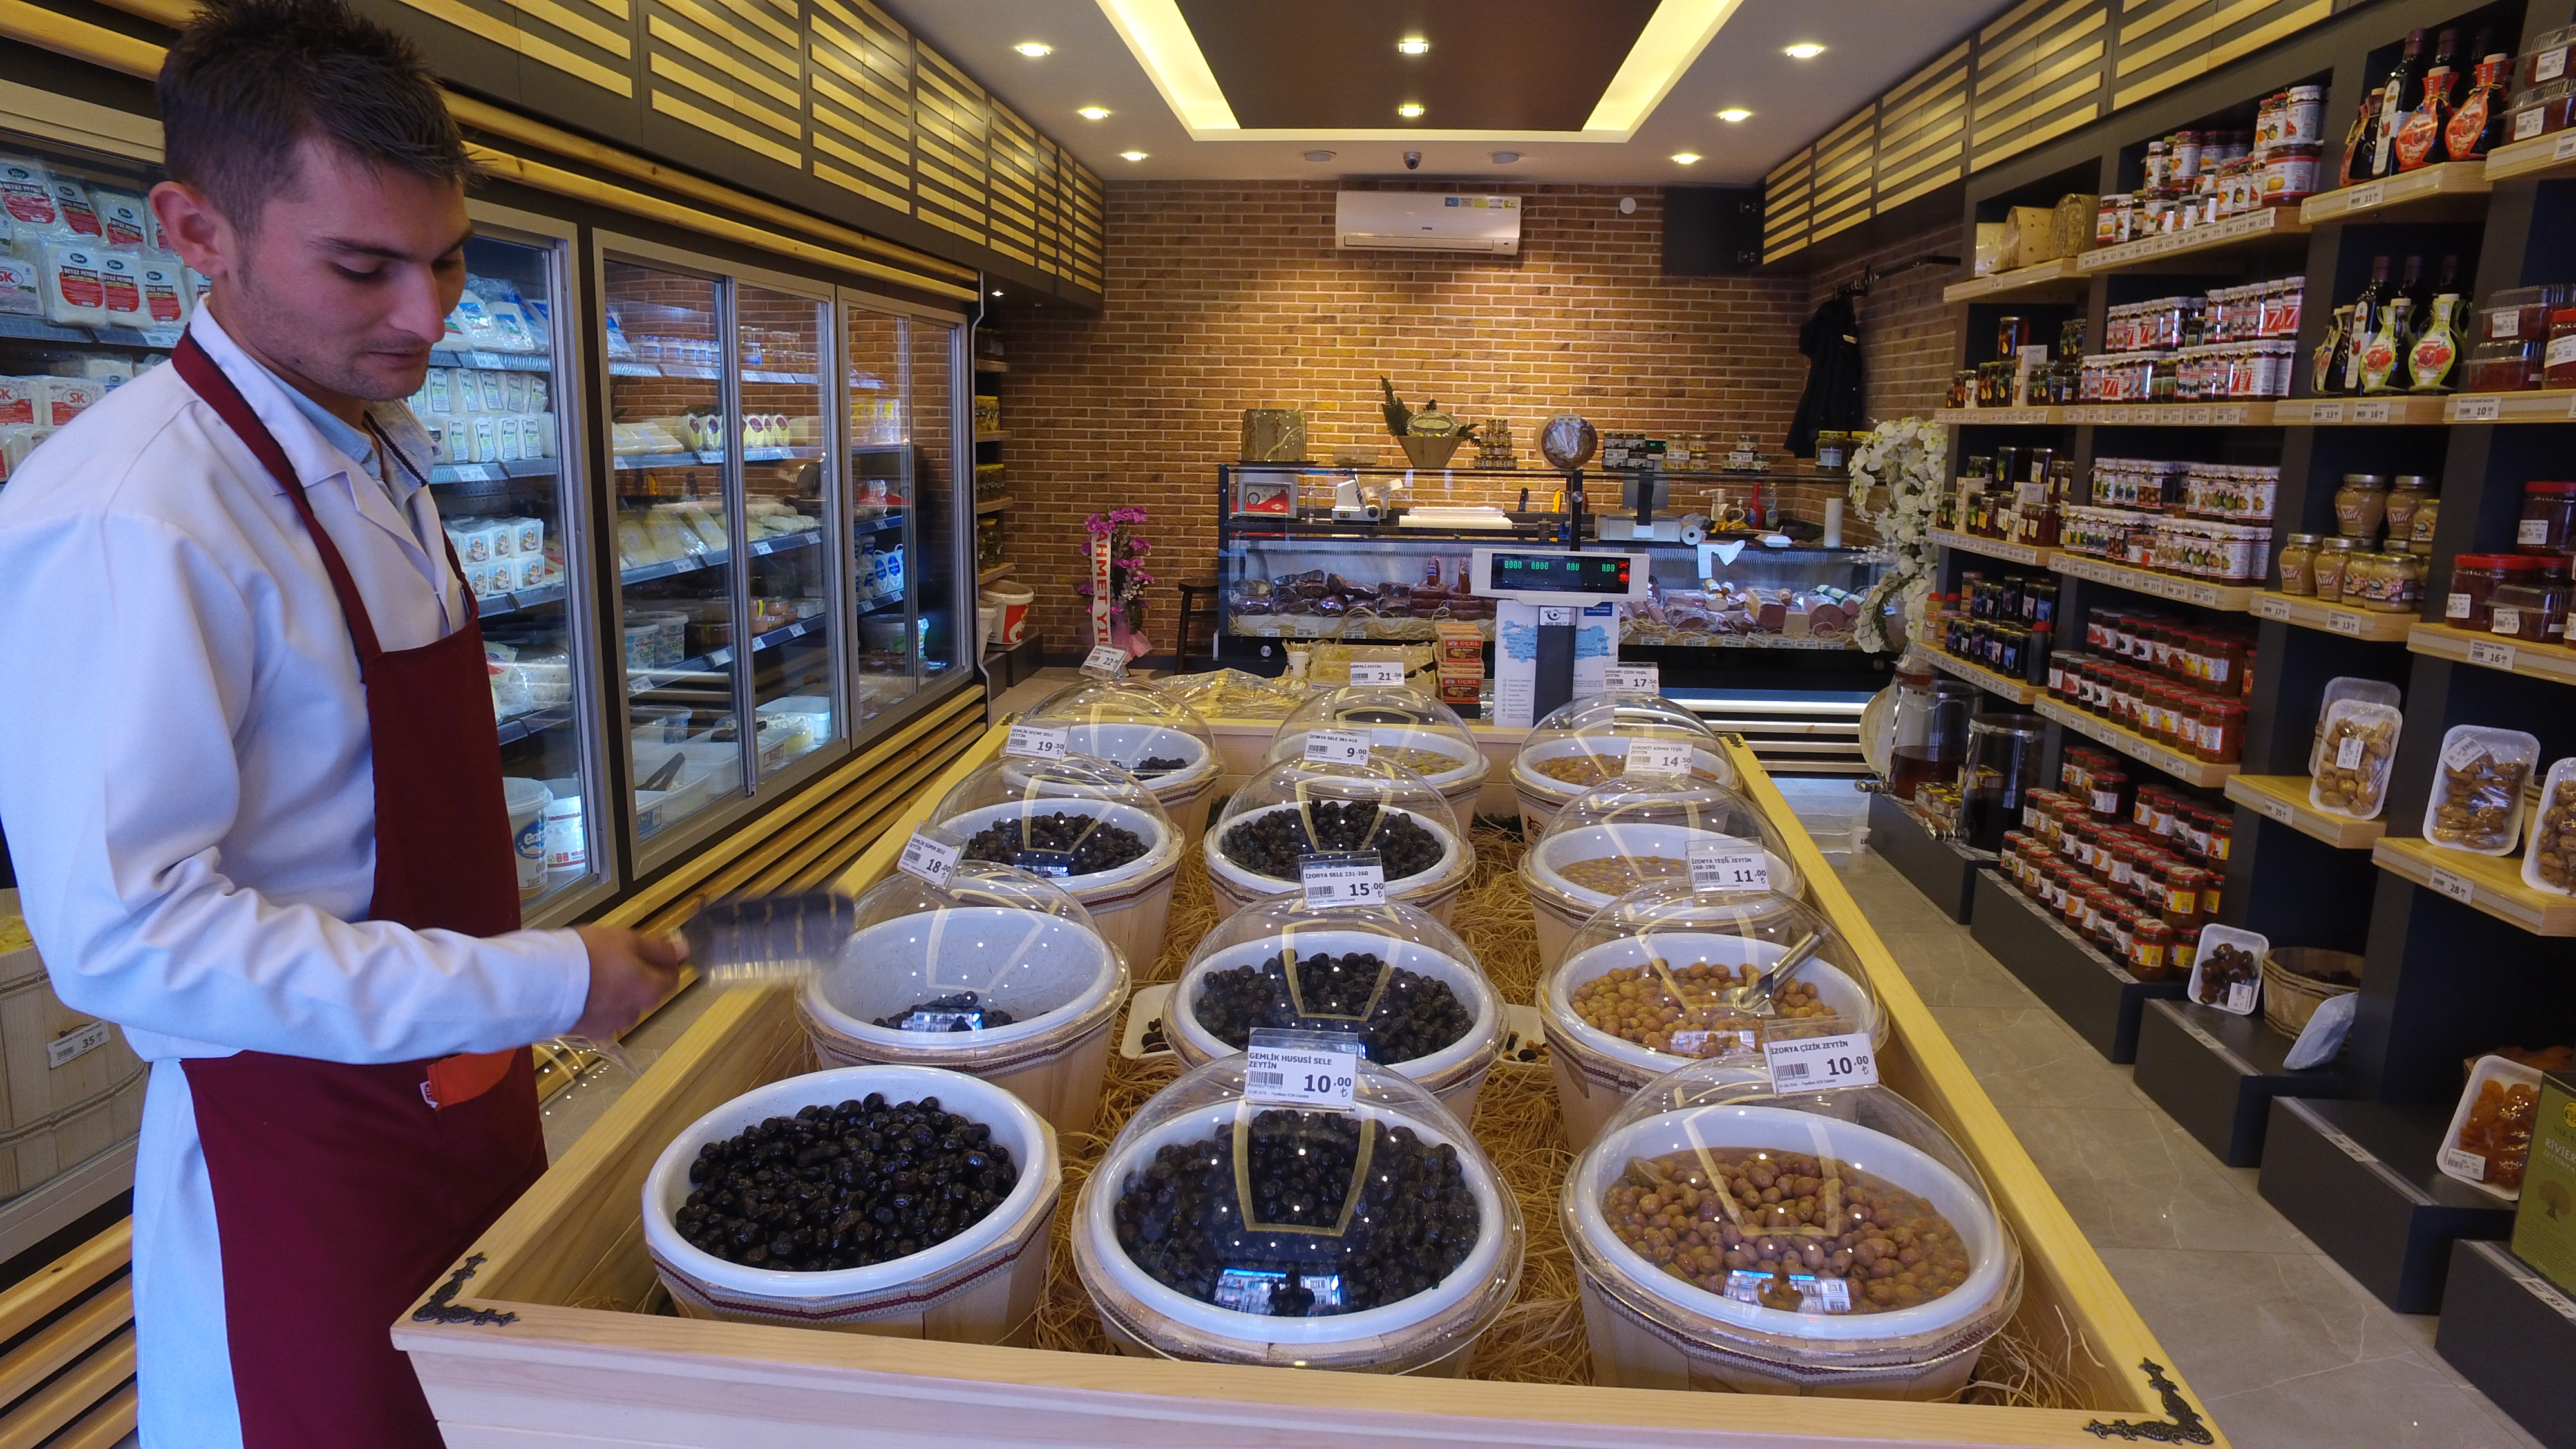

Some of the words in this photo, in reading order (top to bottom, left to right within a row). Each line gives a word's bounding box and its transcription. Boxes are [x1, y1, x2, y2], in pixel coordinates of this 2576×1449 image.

[70, 392, 86, 404] SK
[1096, 531, 1108, 605] AHMET
[1771, 1046, 1799, 1055] İZORYA
[1800, 1043, 1822, 1053] ÇİZİK
[1822, 1039, 1848, 1050] ZEYTİN
[1248, 1061, 1276, 1069] ZEYTİN
[1249, 1052, 1280, 1061] GEMLİK
[1282, 1054, 1312, 1064] HUSUSİ
[1313, 1057, 1332, 1066] SELE
